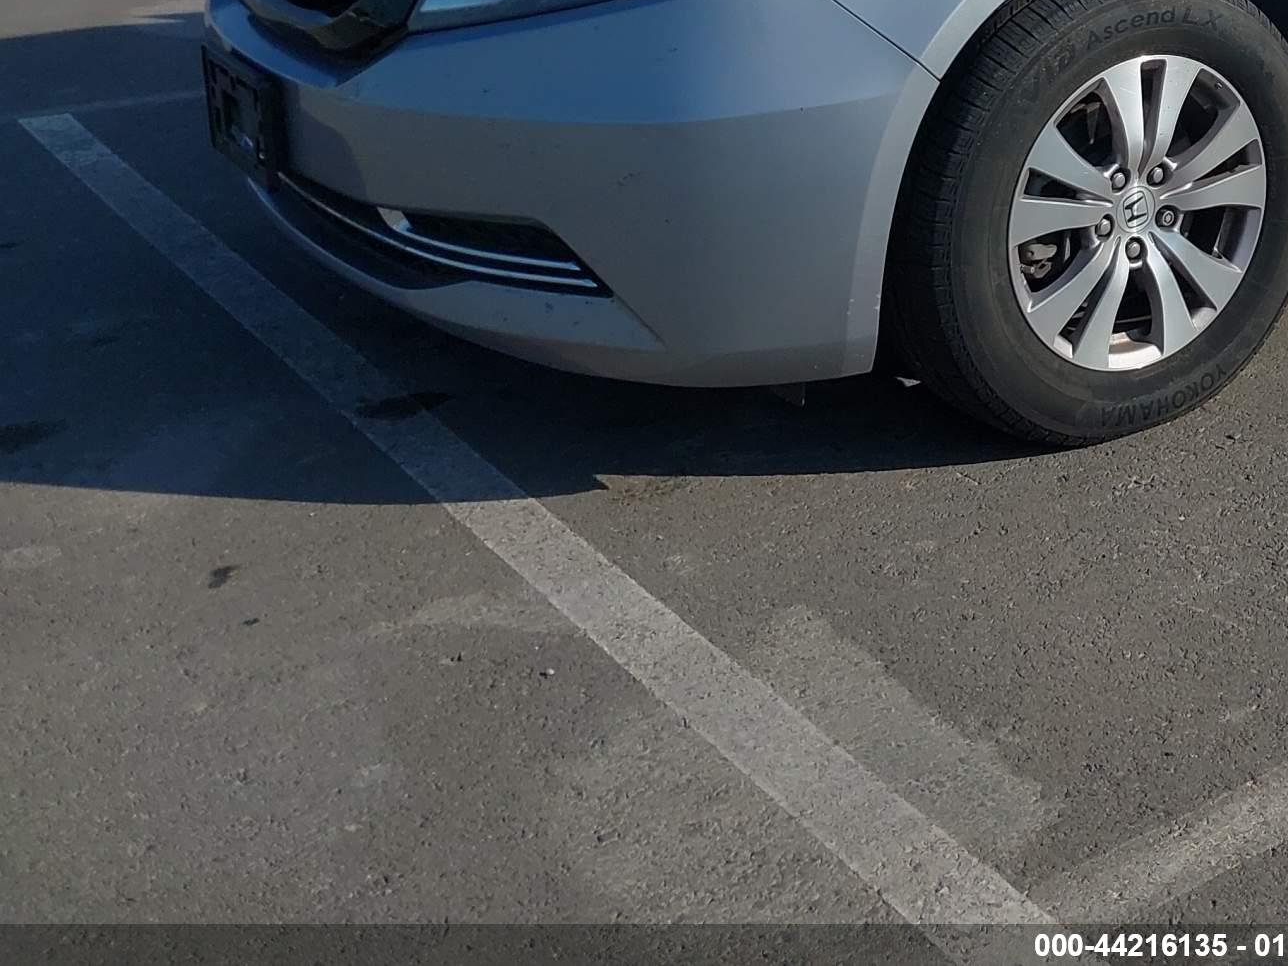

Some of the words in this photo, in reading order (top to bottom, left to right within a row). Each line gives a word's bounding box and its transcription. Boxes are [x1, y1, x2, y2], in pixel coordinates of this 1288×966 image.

[1087, 7, 1176, 49] Ascend
[1182, 7, 1223, 30] LX
[1102, 363, 1227, 427] YOKOHAMA
